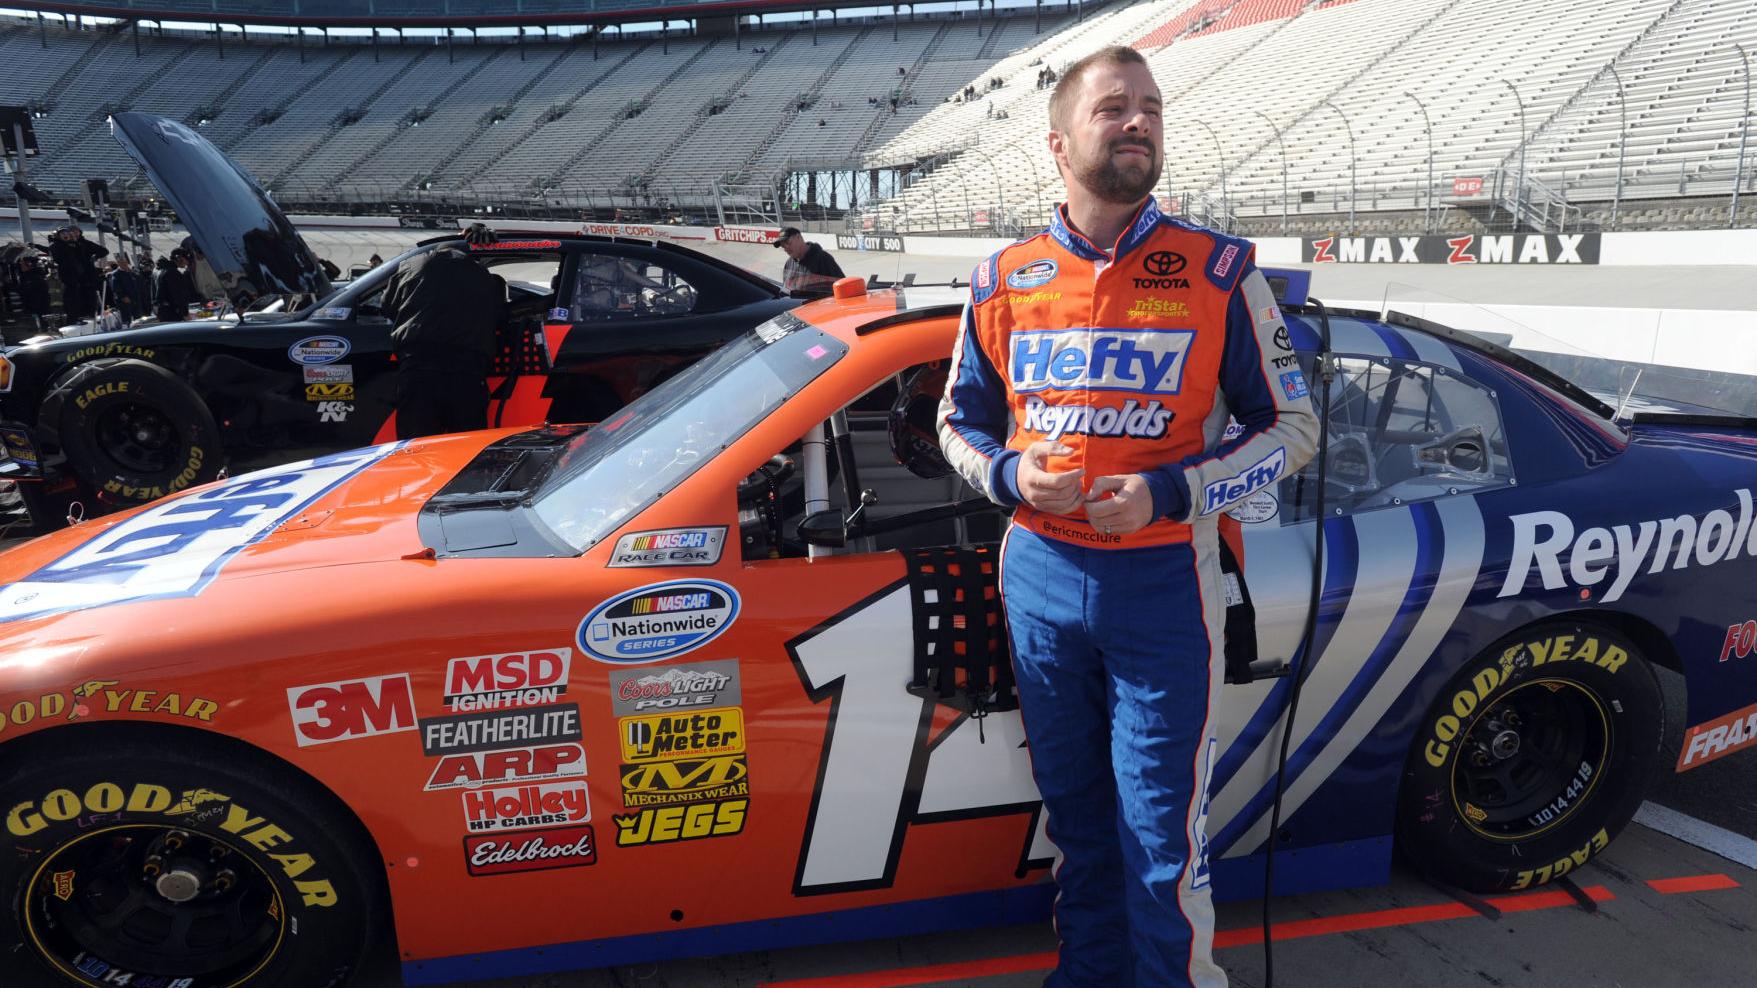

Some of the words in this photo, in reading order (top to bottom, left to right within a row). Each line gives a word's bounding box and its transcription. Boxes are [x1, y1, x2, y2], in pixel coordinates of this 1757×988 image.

[839, 236, 856, 249] FOOD
[865, 236, 880, 250] CITY
[884, 238, 899, 251] 500
[1133, 278, 1190, 289] TOYOTA
[1135, 300, 1185, 312] TriStar
[1014, 337, 1180, 394] Hefty
[75, 381, 129, 410] EAGLE
[1024, 396, 1175, 441] Reynolds
[1207, 460, 1281, 511] Hefty
[654, 533, 702, 549] NASCAR
[1043, 520, 1122, 543] @ericmcclure
[618, 551, 666, 562] RACE
[669, 551, 709, 560] CAR
[656, 593, 709, 612] NASCAR
[612, 614, 718, 637] Nationwide
[623, 638, 676, 651] SERIES
[1719, 619, 1757, 662] FO
[450, 652, 563, 694] MSD
[451, 687, 558, 713] IGNITION
[618, 679, 672, 701] Coors
[673, 675, 731, 695] LIGHT
[296, 677, 415, 740] 3M
[635, 694, 714, 711] POLE
[426, 709, 577, 749] FEATHERLITE
[656, 714, 721, 736] Auto
[650, 731, 737, 757] Meter
[430, 745, 582, 785] ARP
[465, 787, 587, 821] Holley
[624, 791, 702, 807] MECHANIX
[705, 782, 748, 800] WEAR
[470, 821, 495, 830] HP
[502, 813, 567, 827] CARBS
[616, 799, 747, 845] JEGS
[471, 835, 591, 866] Edelbrock
[1509, 828, 1609, 890] EAGLE
